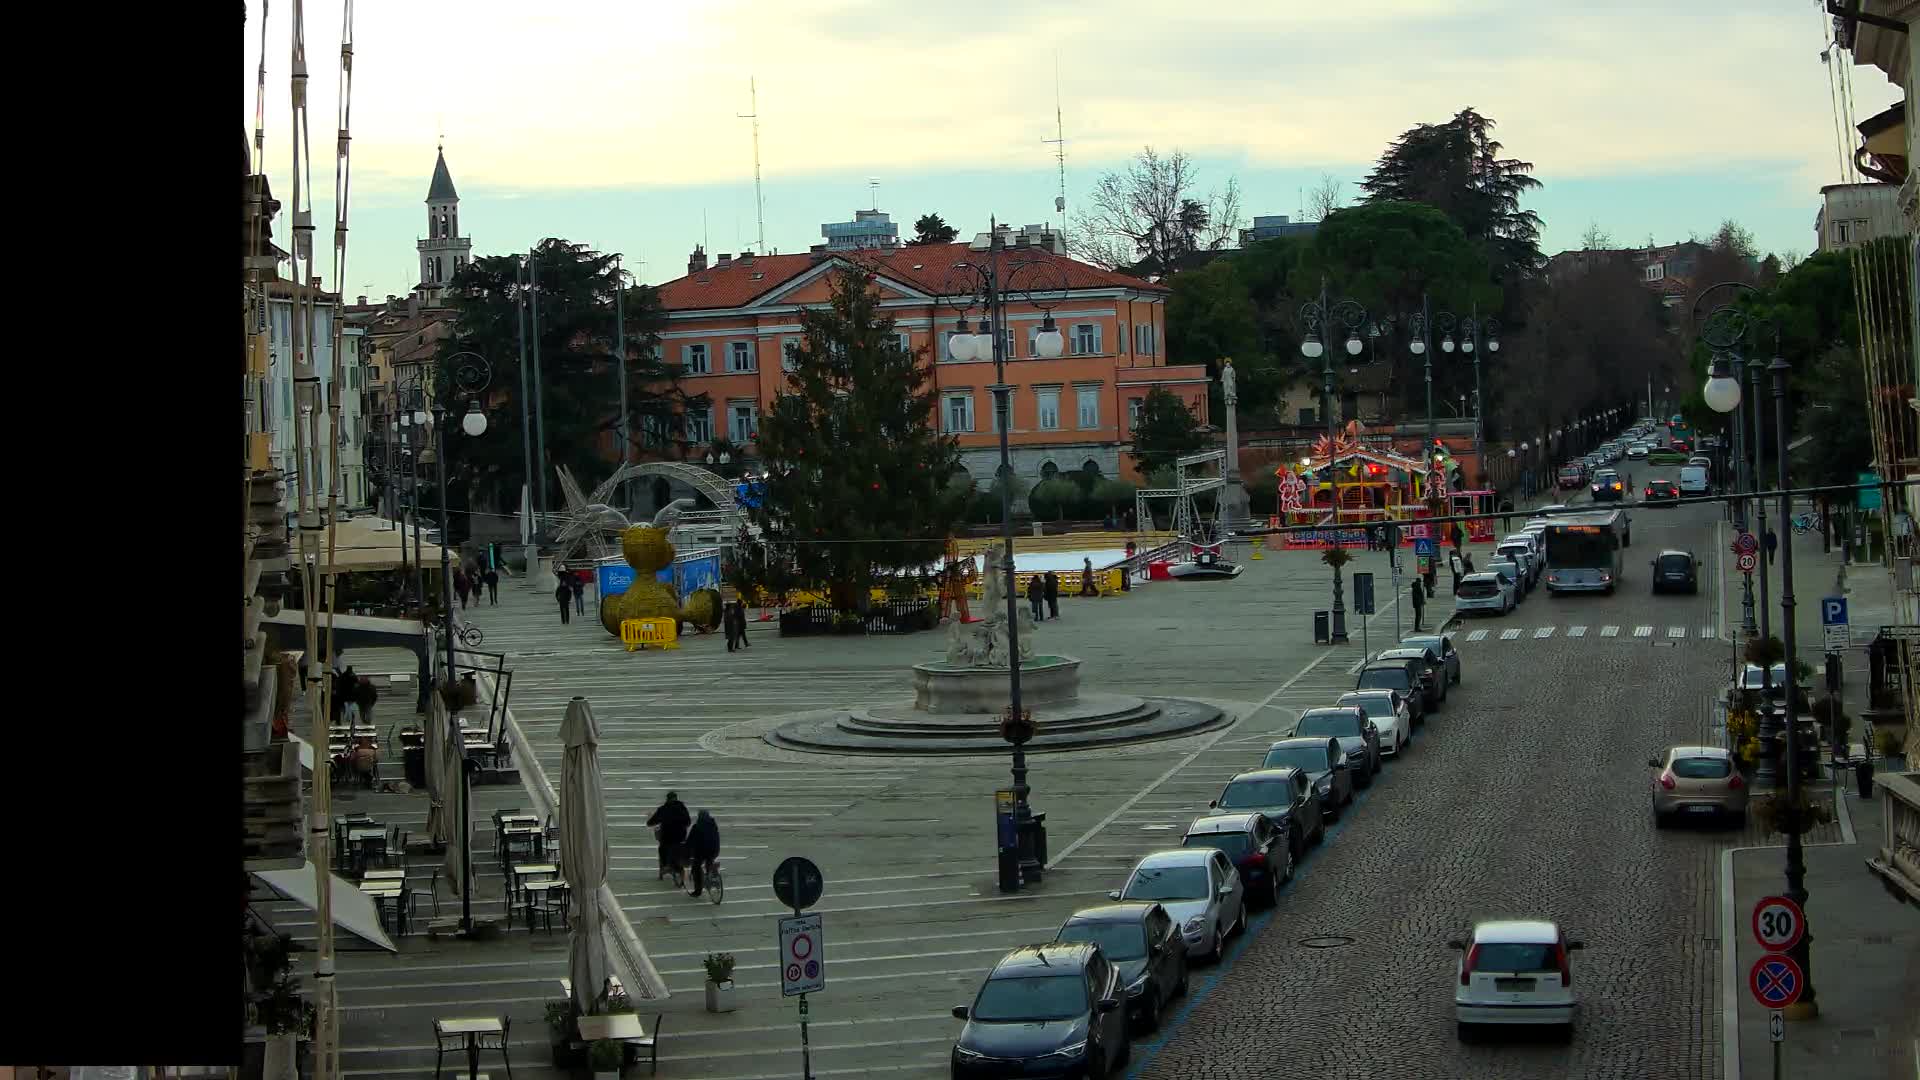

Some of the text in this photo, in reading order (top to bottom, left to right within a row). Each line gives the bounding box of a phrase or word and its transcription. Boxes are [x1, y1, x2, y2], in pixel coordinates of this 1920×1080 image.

[1742, 558, 1752, 567] 20
[1827, 602, 1841, 621] P
[1762, 912, 1791, 937] 30
